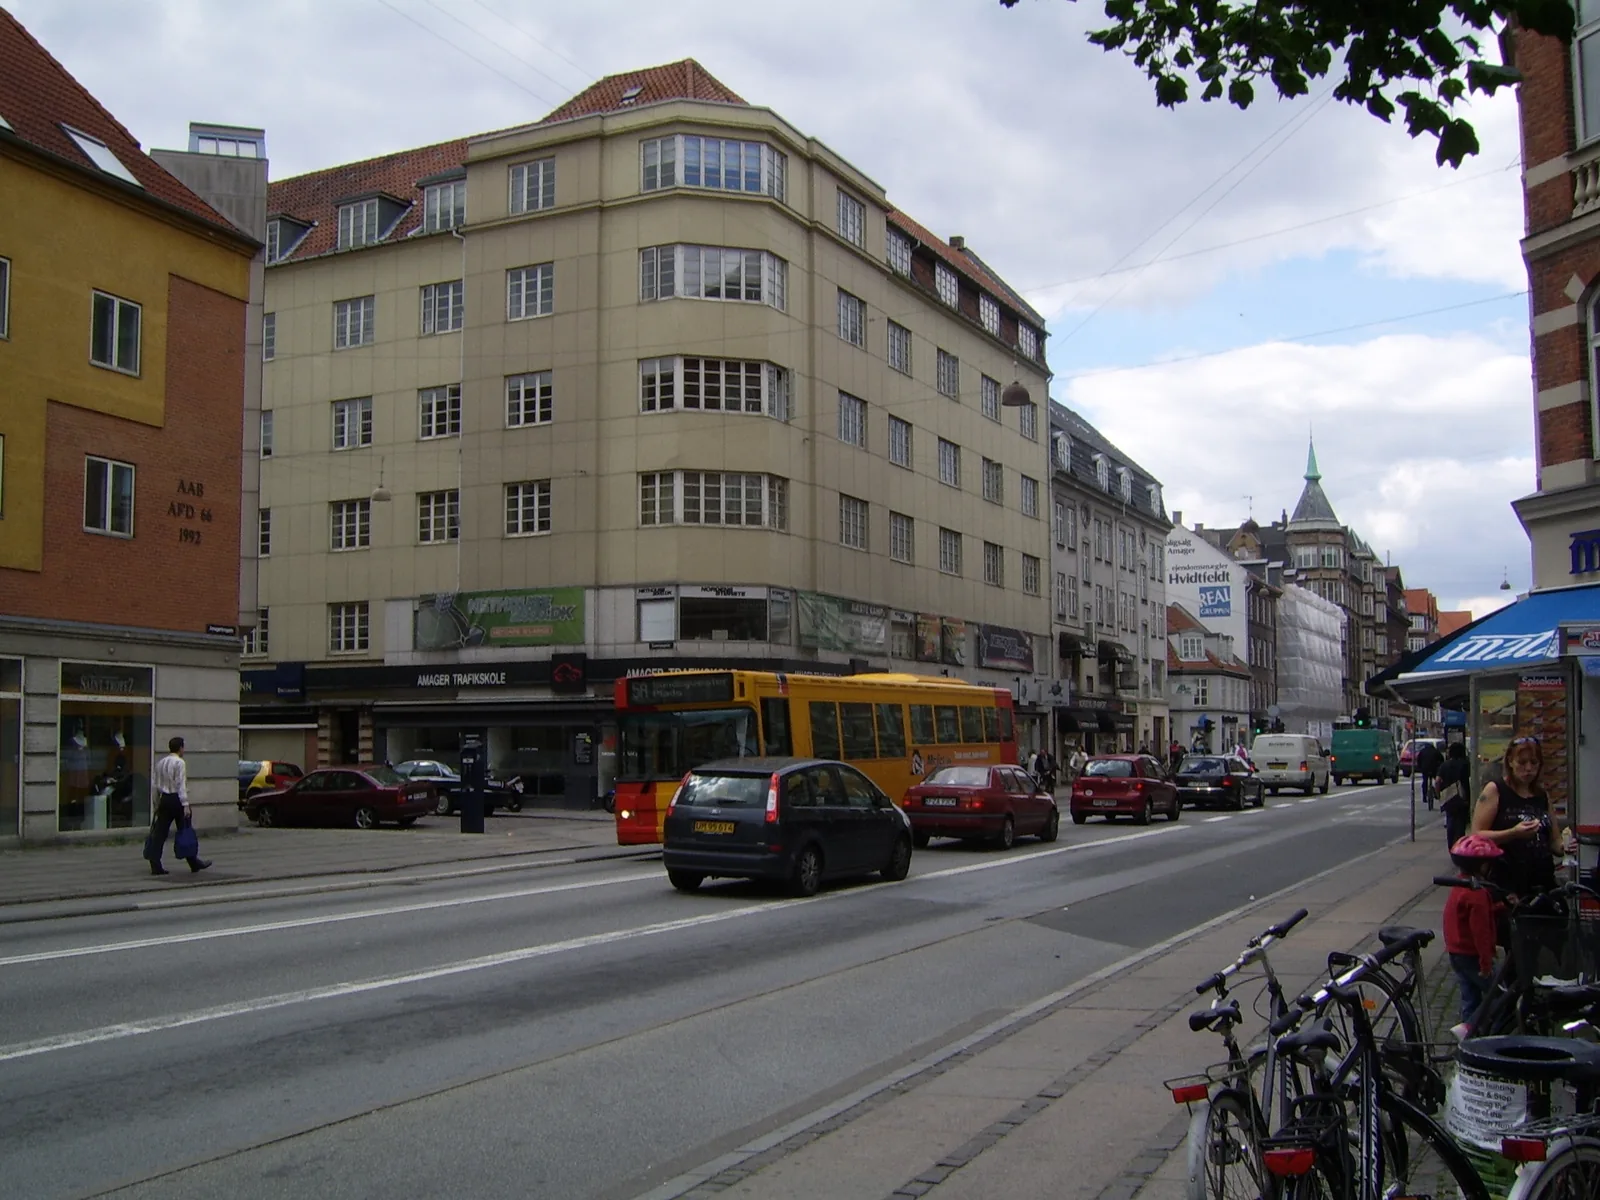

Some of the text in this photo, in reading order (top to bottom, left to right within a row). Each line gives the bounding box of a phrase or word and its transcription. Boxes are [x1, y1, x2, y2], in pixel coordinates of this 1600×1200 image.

[177, 479, 204, 497] AAB
[168, 501, 212, 522] AFD 66
[179, 527, 201, 545] 1992
[1168, 547, 1195, 555] Amager
[1169, 570, 1230, 584] Hvidtfeldt
[1200, 587, 1230, 608] REAL
[1200, 607, 1230, 615] GRUPPEN
[417, 672, 507, 687] AMAGER TRAFIKSKOLE
[1521, 674, 1562, 687] Spisekort
